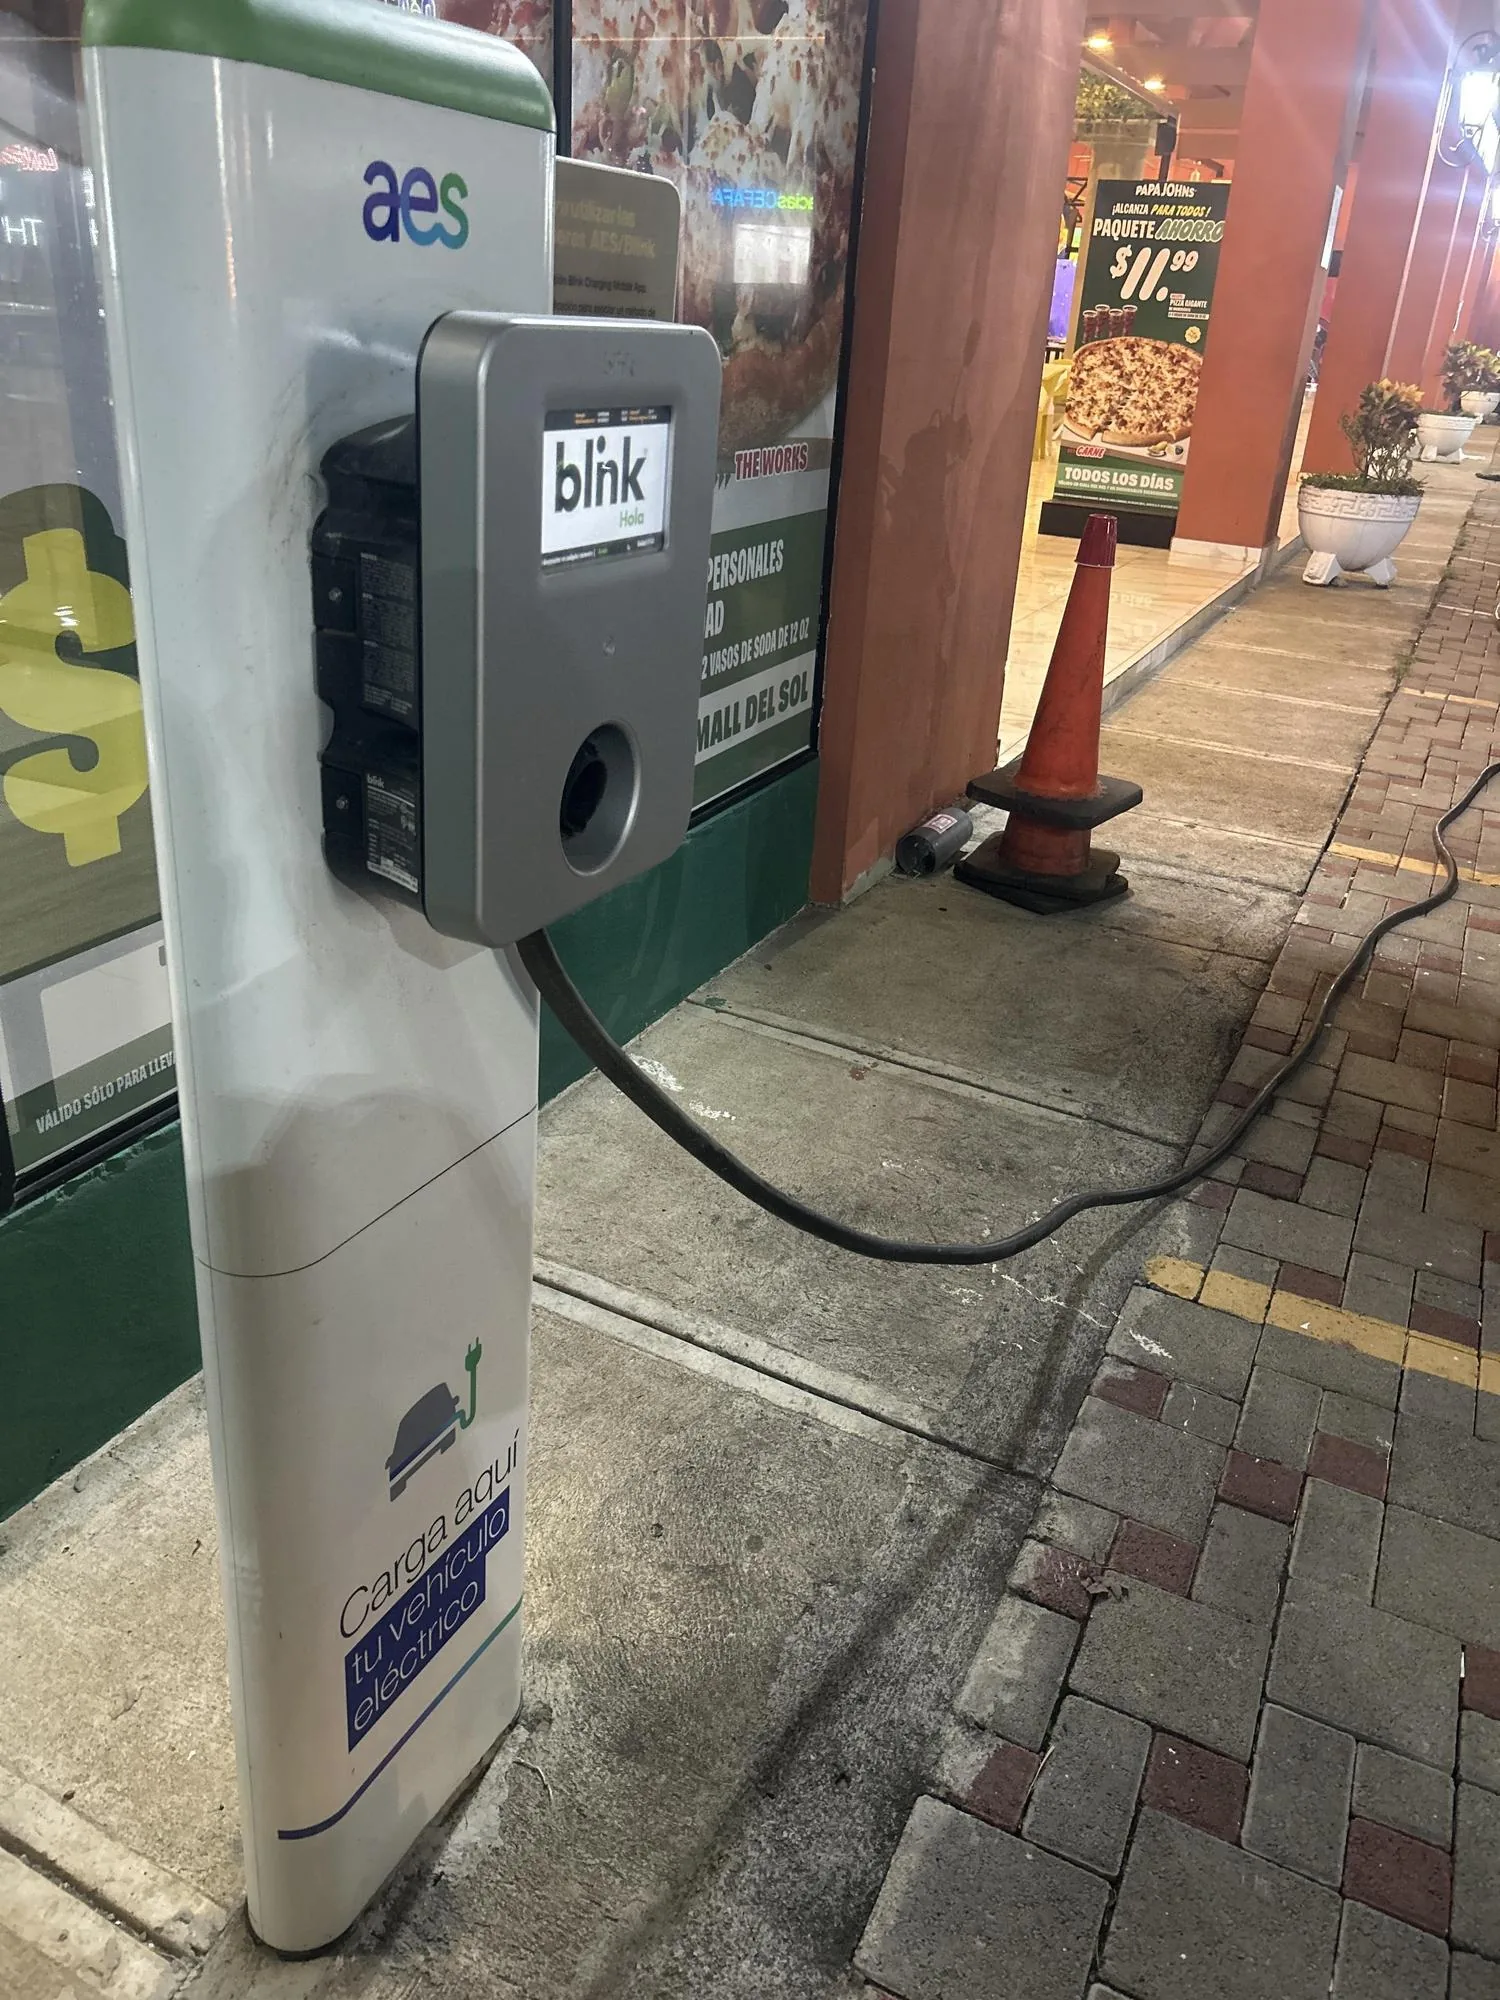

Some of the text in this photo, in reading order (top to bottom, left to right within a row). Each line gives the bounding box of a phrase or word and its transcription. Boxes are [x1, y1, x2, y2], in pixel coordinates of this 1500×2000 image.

[363, 160, 469, 250] aes
[1093, 218, 1226, 242] PAQUETE AHORRO
[1150, 204, 1173, 216] PARA
[555, 435, 647, 513] blink
[735, 442, 809, 481] THE WORKS
[1065, 467, 1111, 483] TODOS
[1112, 472, 1138, 486] LOS
[1140, 473, 1175, 491] DÍAS
[620, 508, 645, 528] Hola
[709, 643, 740, 676] VASOS
[740, 638, 753, 664] DE
[753, 629, 777, 659] SODA
[777, 624, 789, 650] DE
[789, 621, 799, 644] 12
[799, 617, 810, 641] OZ
[697, 671, 808, 752] MALL DEL SOL
[35, 1098, 82, 1134] VÁLIDO
[83, 1082, 114, 1111] SÓLO
[116, 1064, 148, 1093] PARA
[339, 1427, 519, 1638] Carga aquí
[352, 1508, 506, 1684] tu vehículo
[354, 1581, 478, 1730] eléctrico
